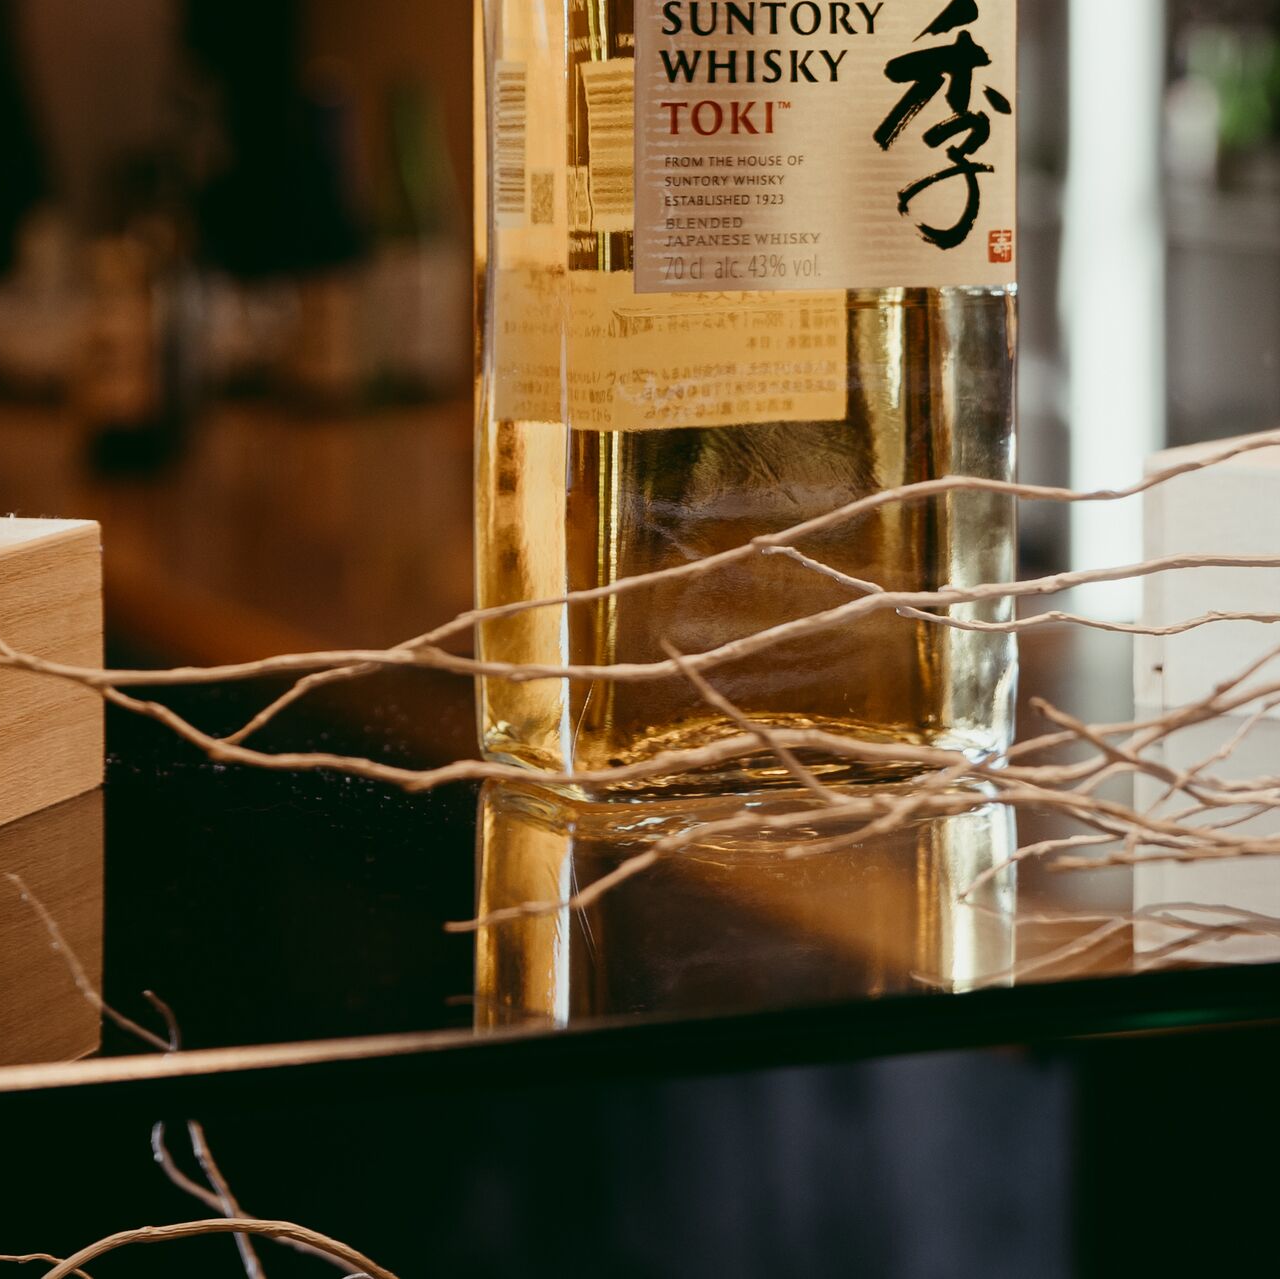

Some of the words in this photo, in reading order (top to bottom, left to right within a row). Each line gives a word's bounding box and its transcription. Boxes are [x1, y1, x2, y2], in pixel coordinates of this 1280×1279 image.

[661, 0, 884, 36] SUNTORY
[659, 49, 848, 84] WHISKY
[664, 156, 703, 167] FROM
[708, 156, 733, 167] THE
[737, 155, 782, 167] HOUSE
[787, 155, 804, 166] OF
[664, 175, 729, 187] SUNTORY
[733, 174, 785, 186] WHISKY
[664, 195, 751, 207] ESTABLISHED
[756, 194, 784, 205] 1923
[665, 217, 743, 230] BLENDED
[664, 233, 751, 247] JAPANESE
[755, 232, 821, 246] WHISKY
[664, 256, 685, 280] 70
[689, 256, 703, 280] cl
[714, 255, 743, 279] alc.
[747, 254, 786, 278] 43%
[792, 253, 822, 277] vol.
